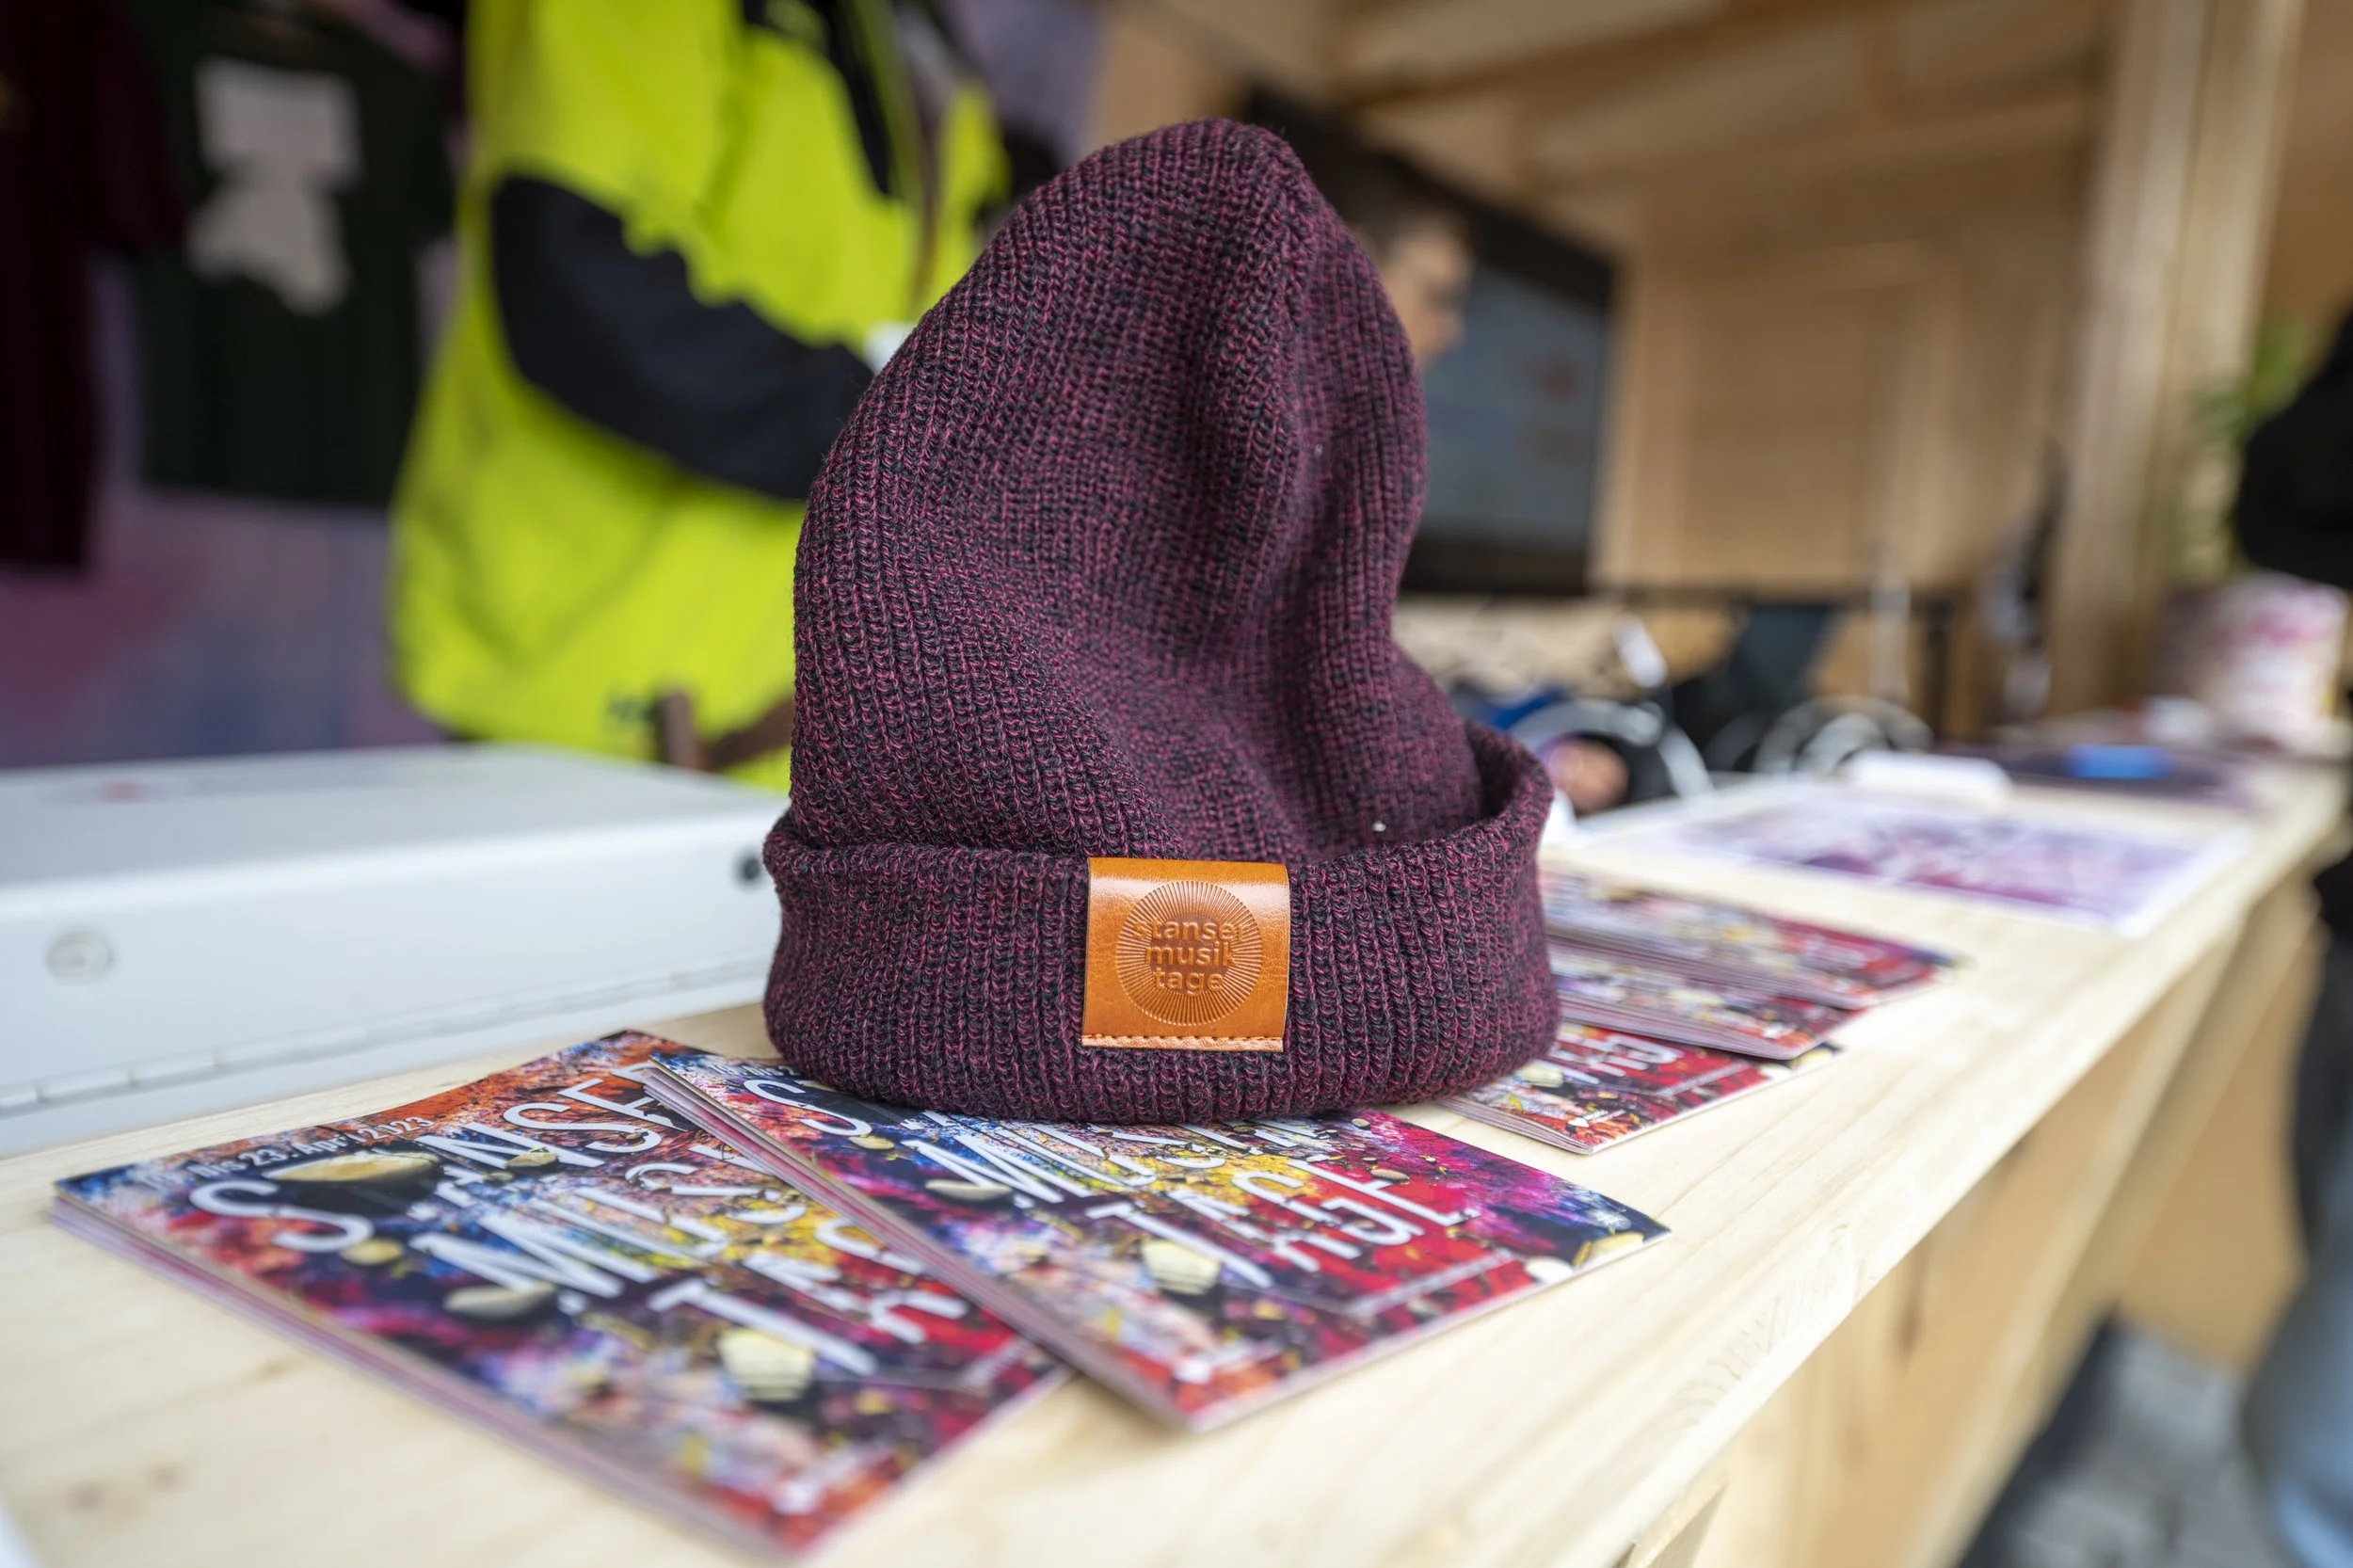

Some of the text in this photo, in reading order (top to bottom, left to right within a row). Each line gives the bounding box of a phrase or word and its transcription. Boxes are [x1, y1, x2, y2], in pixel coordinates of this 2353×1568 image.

[1132, 917, 1251, 942] stanser
[1145, 941, 1239, 966] musik
[1153, 967, 1225, 998] tage
[360, 1116, 435, 1143] 2023
[1086, 1154, 1481, 1288] TAGE
